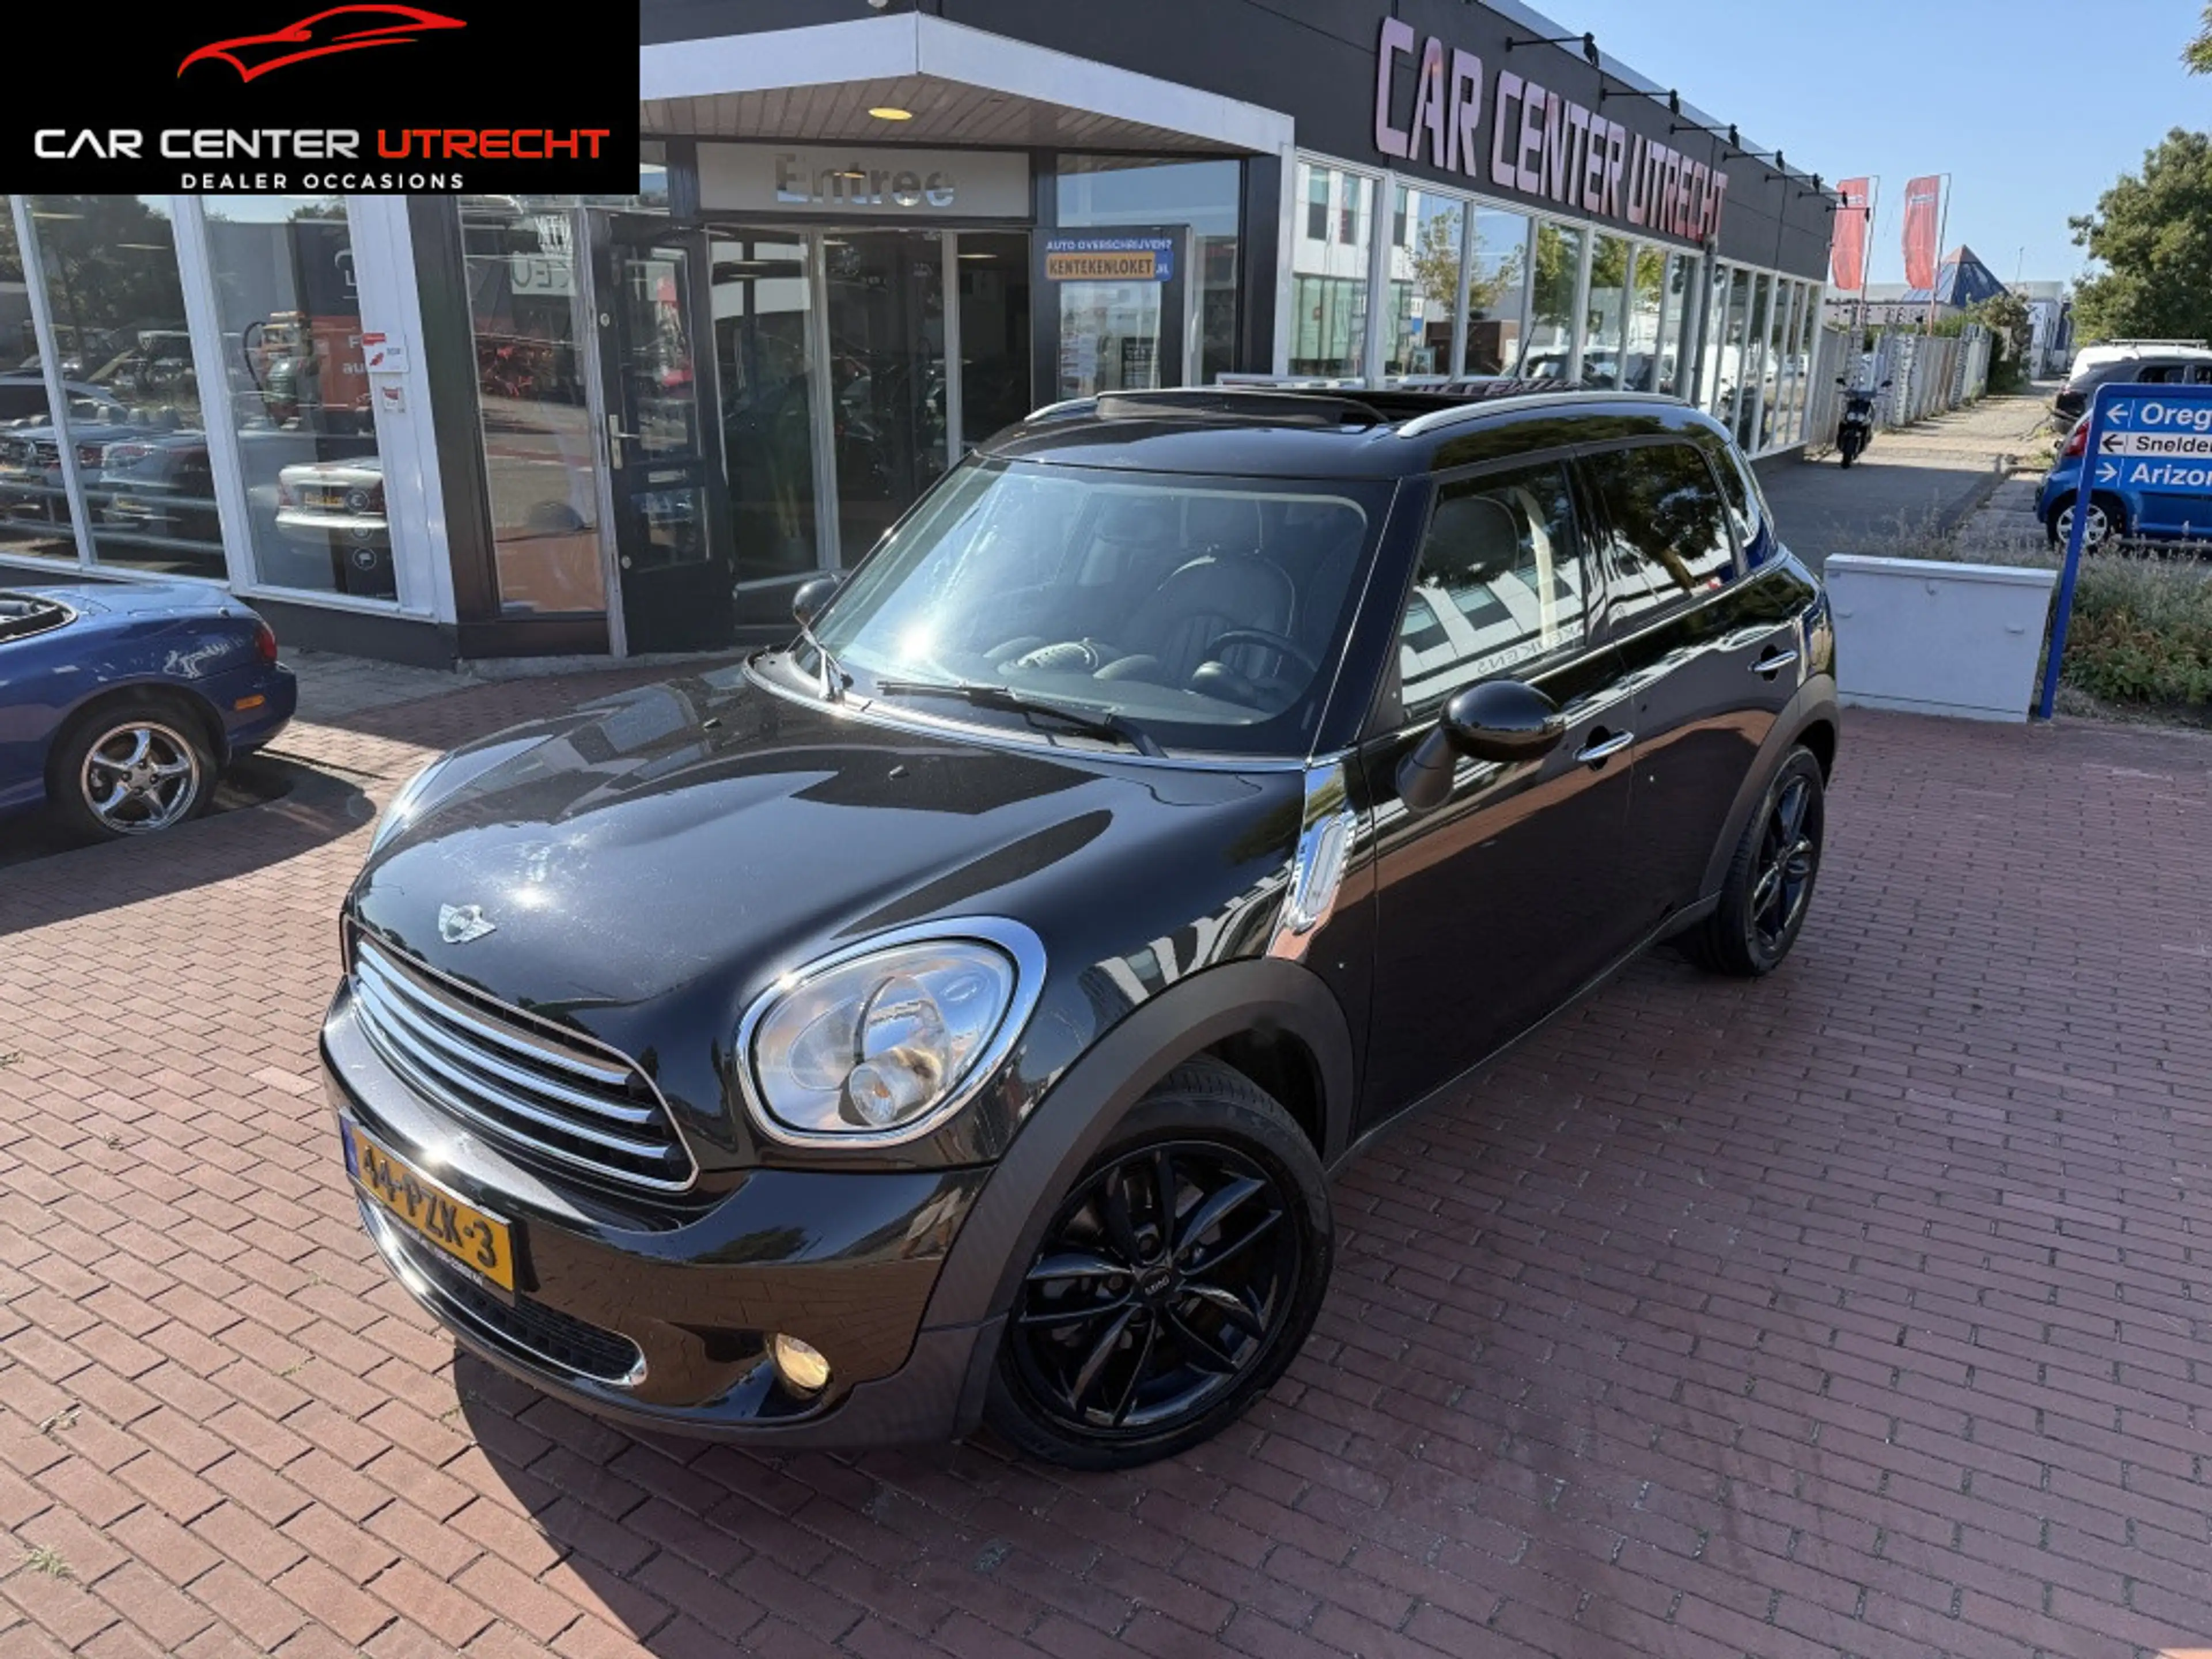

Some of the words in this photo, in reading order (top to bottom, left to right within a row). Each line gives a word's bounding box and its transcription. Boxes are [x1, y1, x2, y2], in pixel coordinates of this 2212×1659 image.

[1375, 16, 1483, 177] CAR
[1491, 69, 1626, 219] CENTER
[1626, 133, 1728, 243] UTRECHT
[775, 153, 954, 207] Entree
[1046, 240, 1076, 250] AUTO
